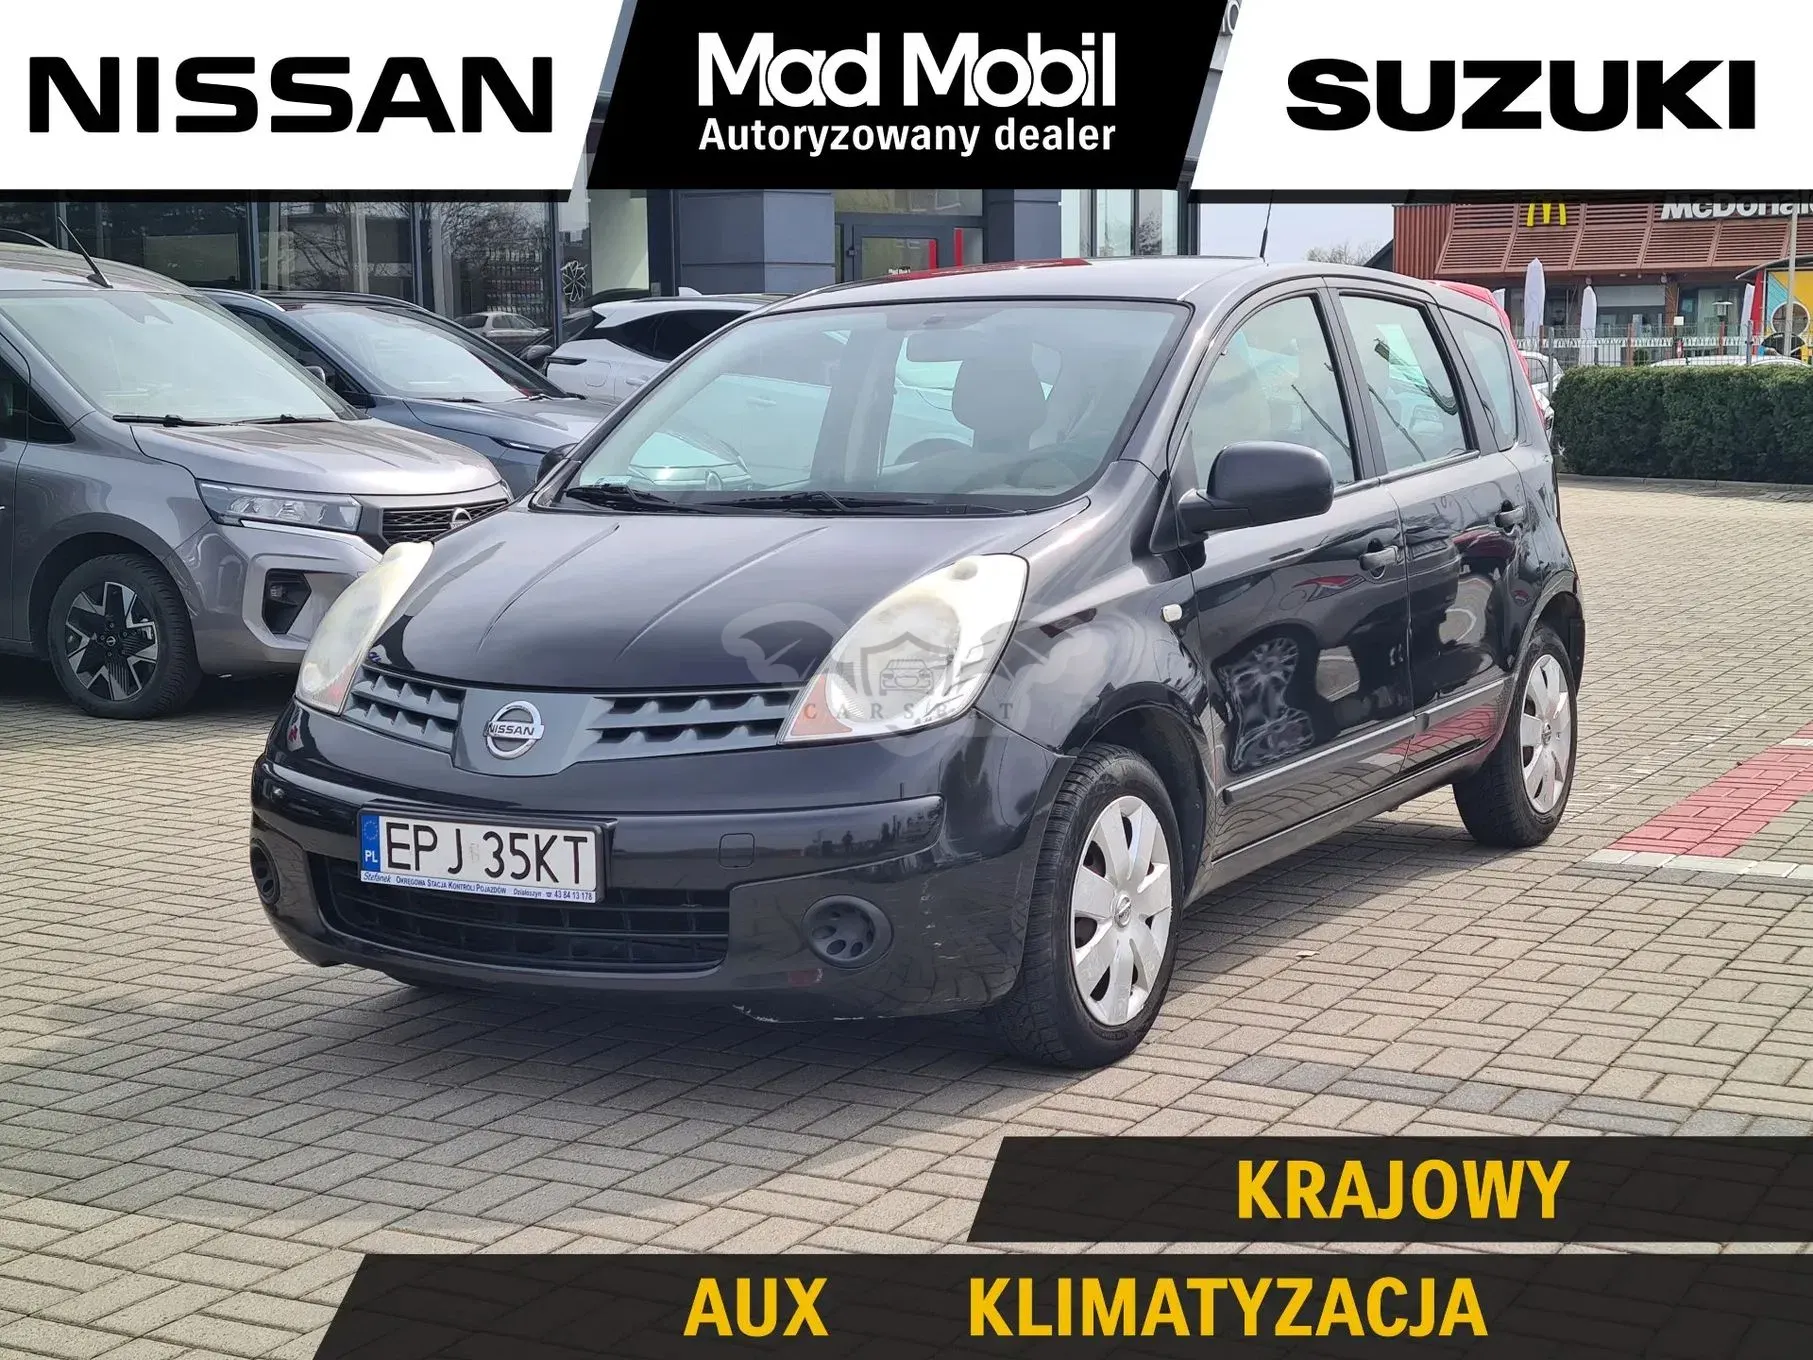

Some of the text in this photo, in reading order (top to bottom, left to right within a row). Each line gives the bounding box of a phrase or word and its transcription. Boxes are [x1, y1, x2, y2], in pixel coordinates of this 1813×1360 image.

[487, 722, 535, 736] NISSAN
[364, 850, 379, 864] PL
[386, 822, 588, 884] EPJ 35KT
[554, 890, 562, 899] 43
[572, 891, 580, 900] 13
[581, 891, 593, 901] 178
